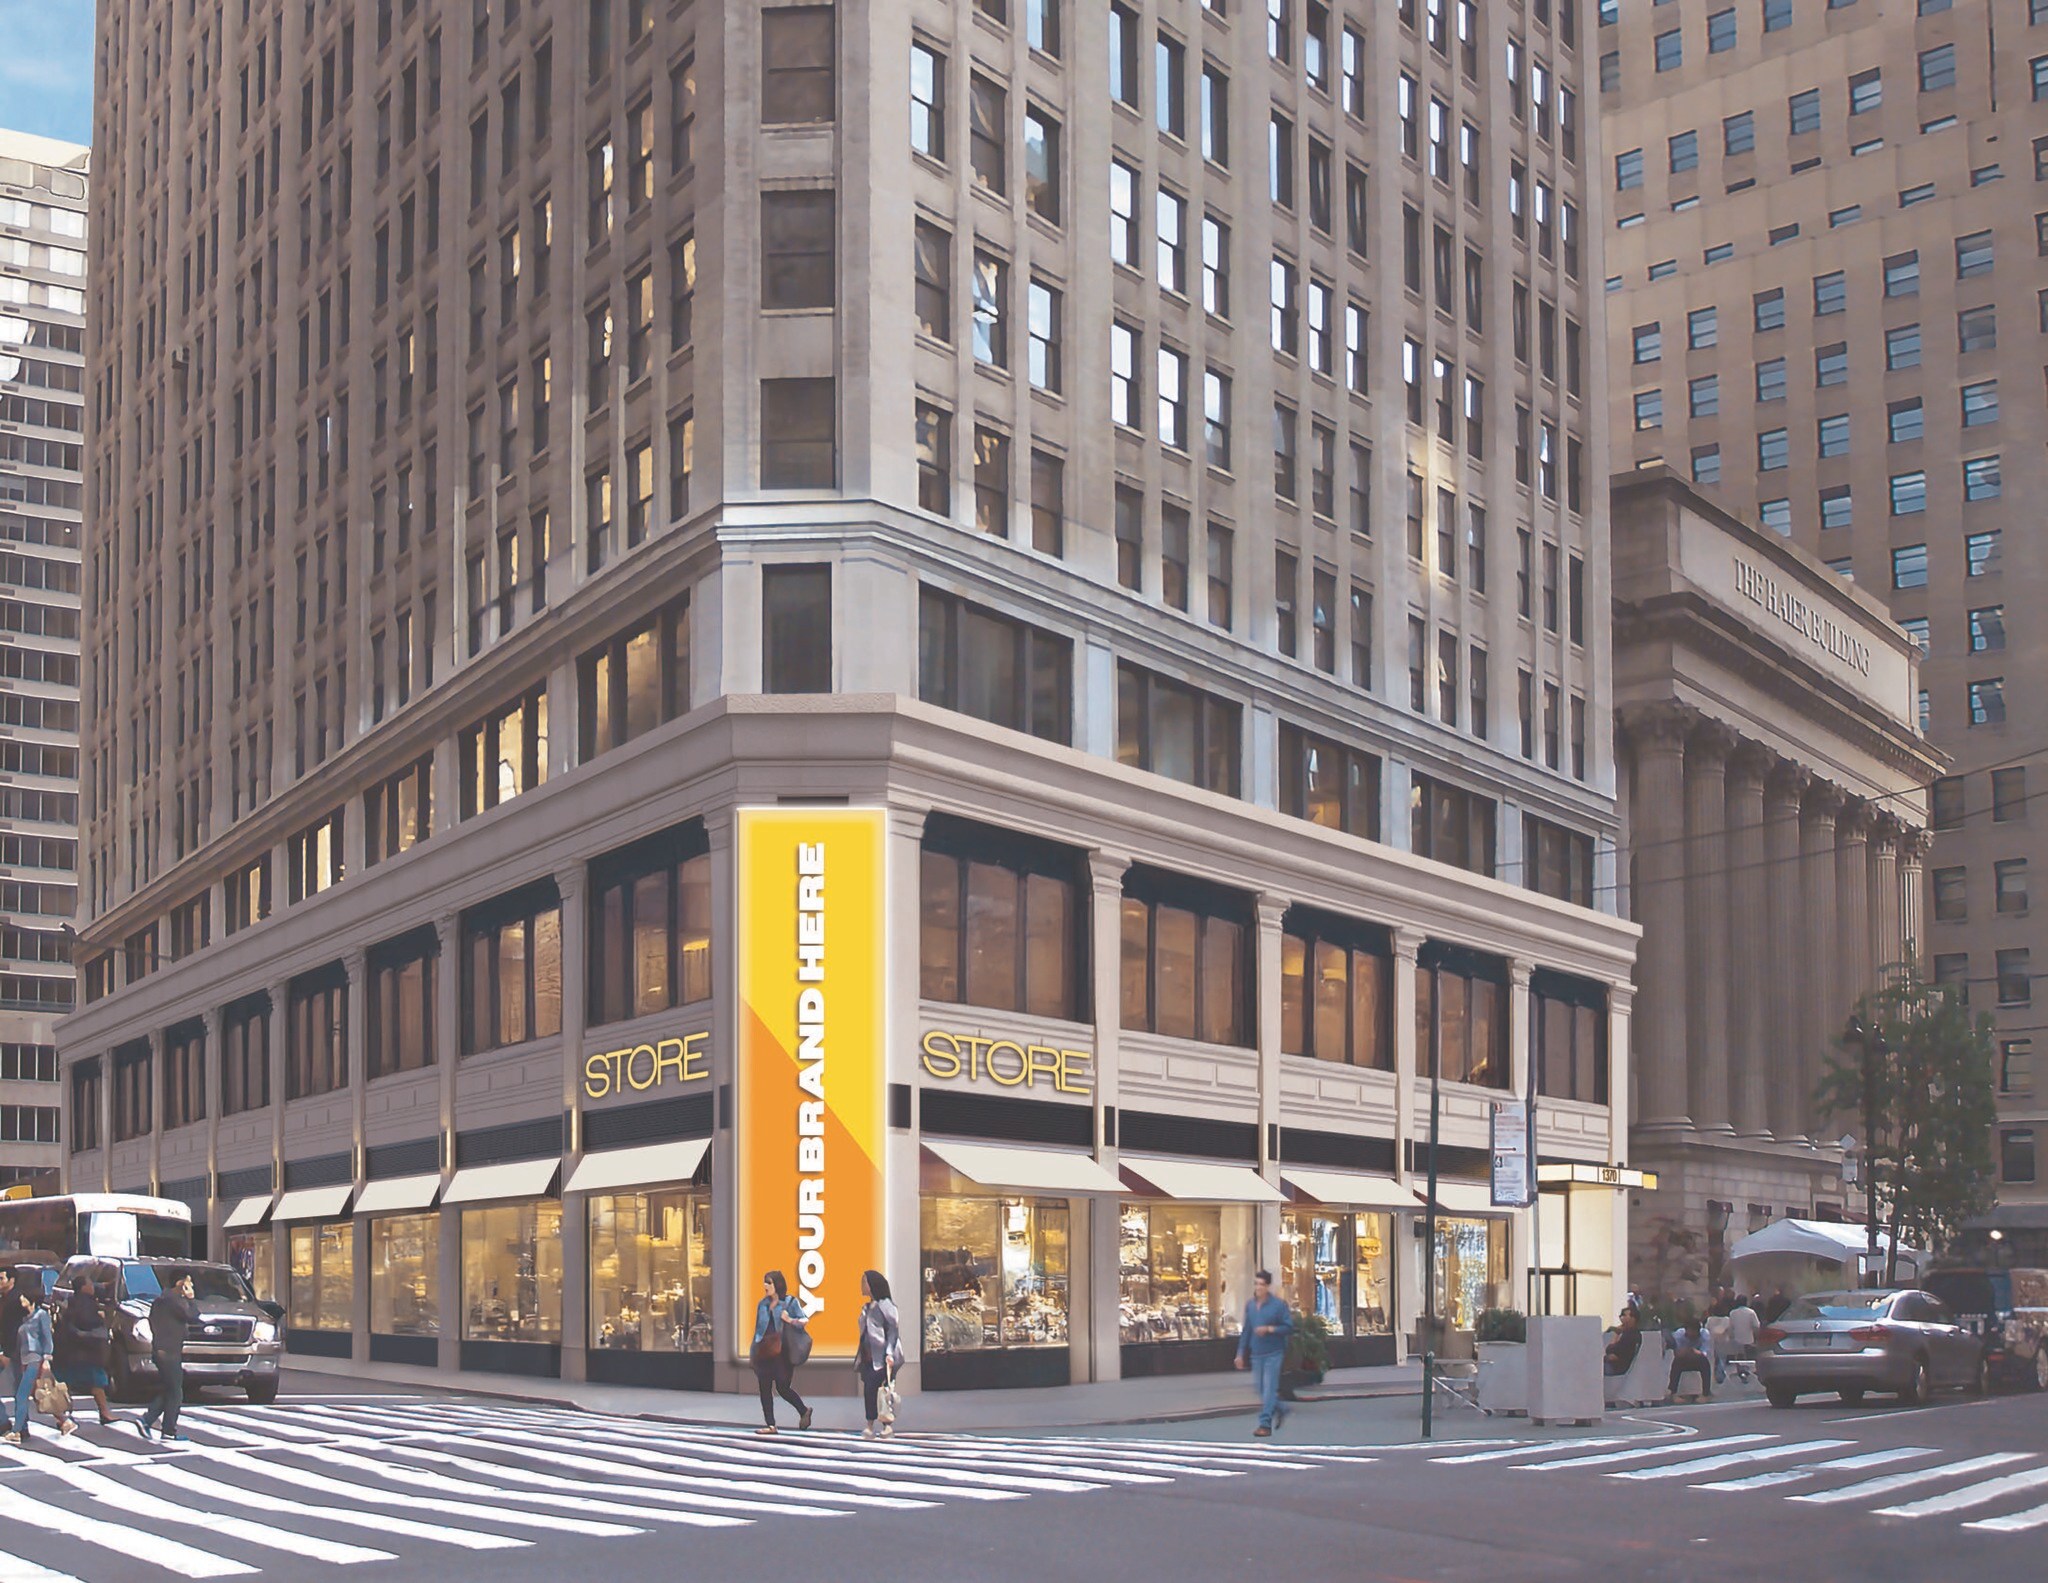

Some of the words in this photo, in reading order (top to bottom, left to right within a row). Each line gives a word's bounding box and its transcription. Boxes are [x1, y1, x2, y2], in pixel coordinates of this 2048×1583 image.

[1734, 556, 1763, 606] THE
[1765, 578, 1809, 638] HAIER
[1810, 610, 1869, 677] BUILDING
[798, 842, 826, 982] HERE
[584, 1031, 709, 1098] STORE
[798, 988, 826, 1172] BRAND
[922, 1031, 1091, 1094] STORE
[1601, 1168, 1617, 1182] 1370
[798, 1178, 826, 1320] YOUR
